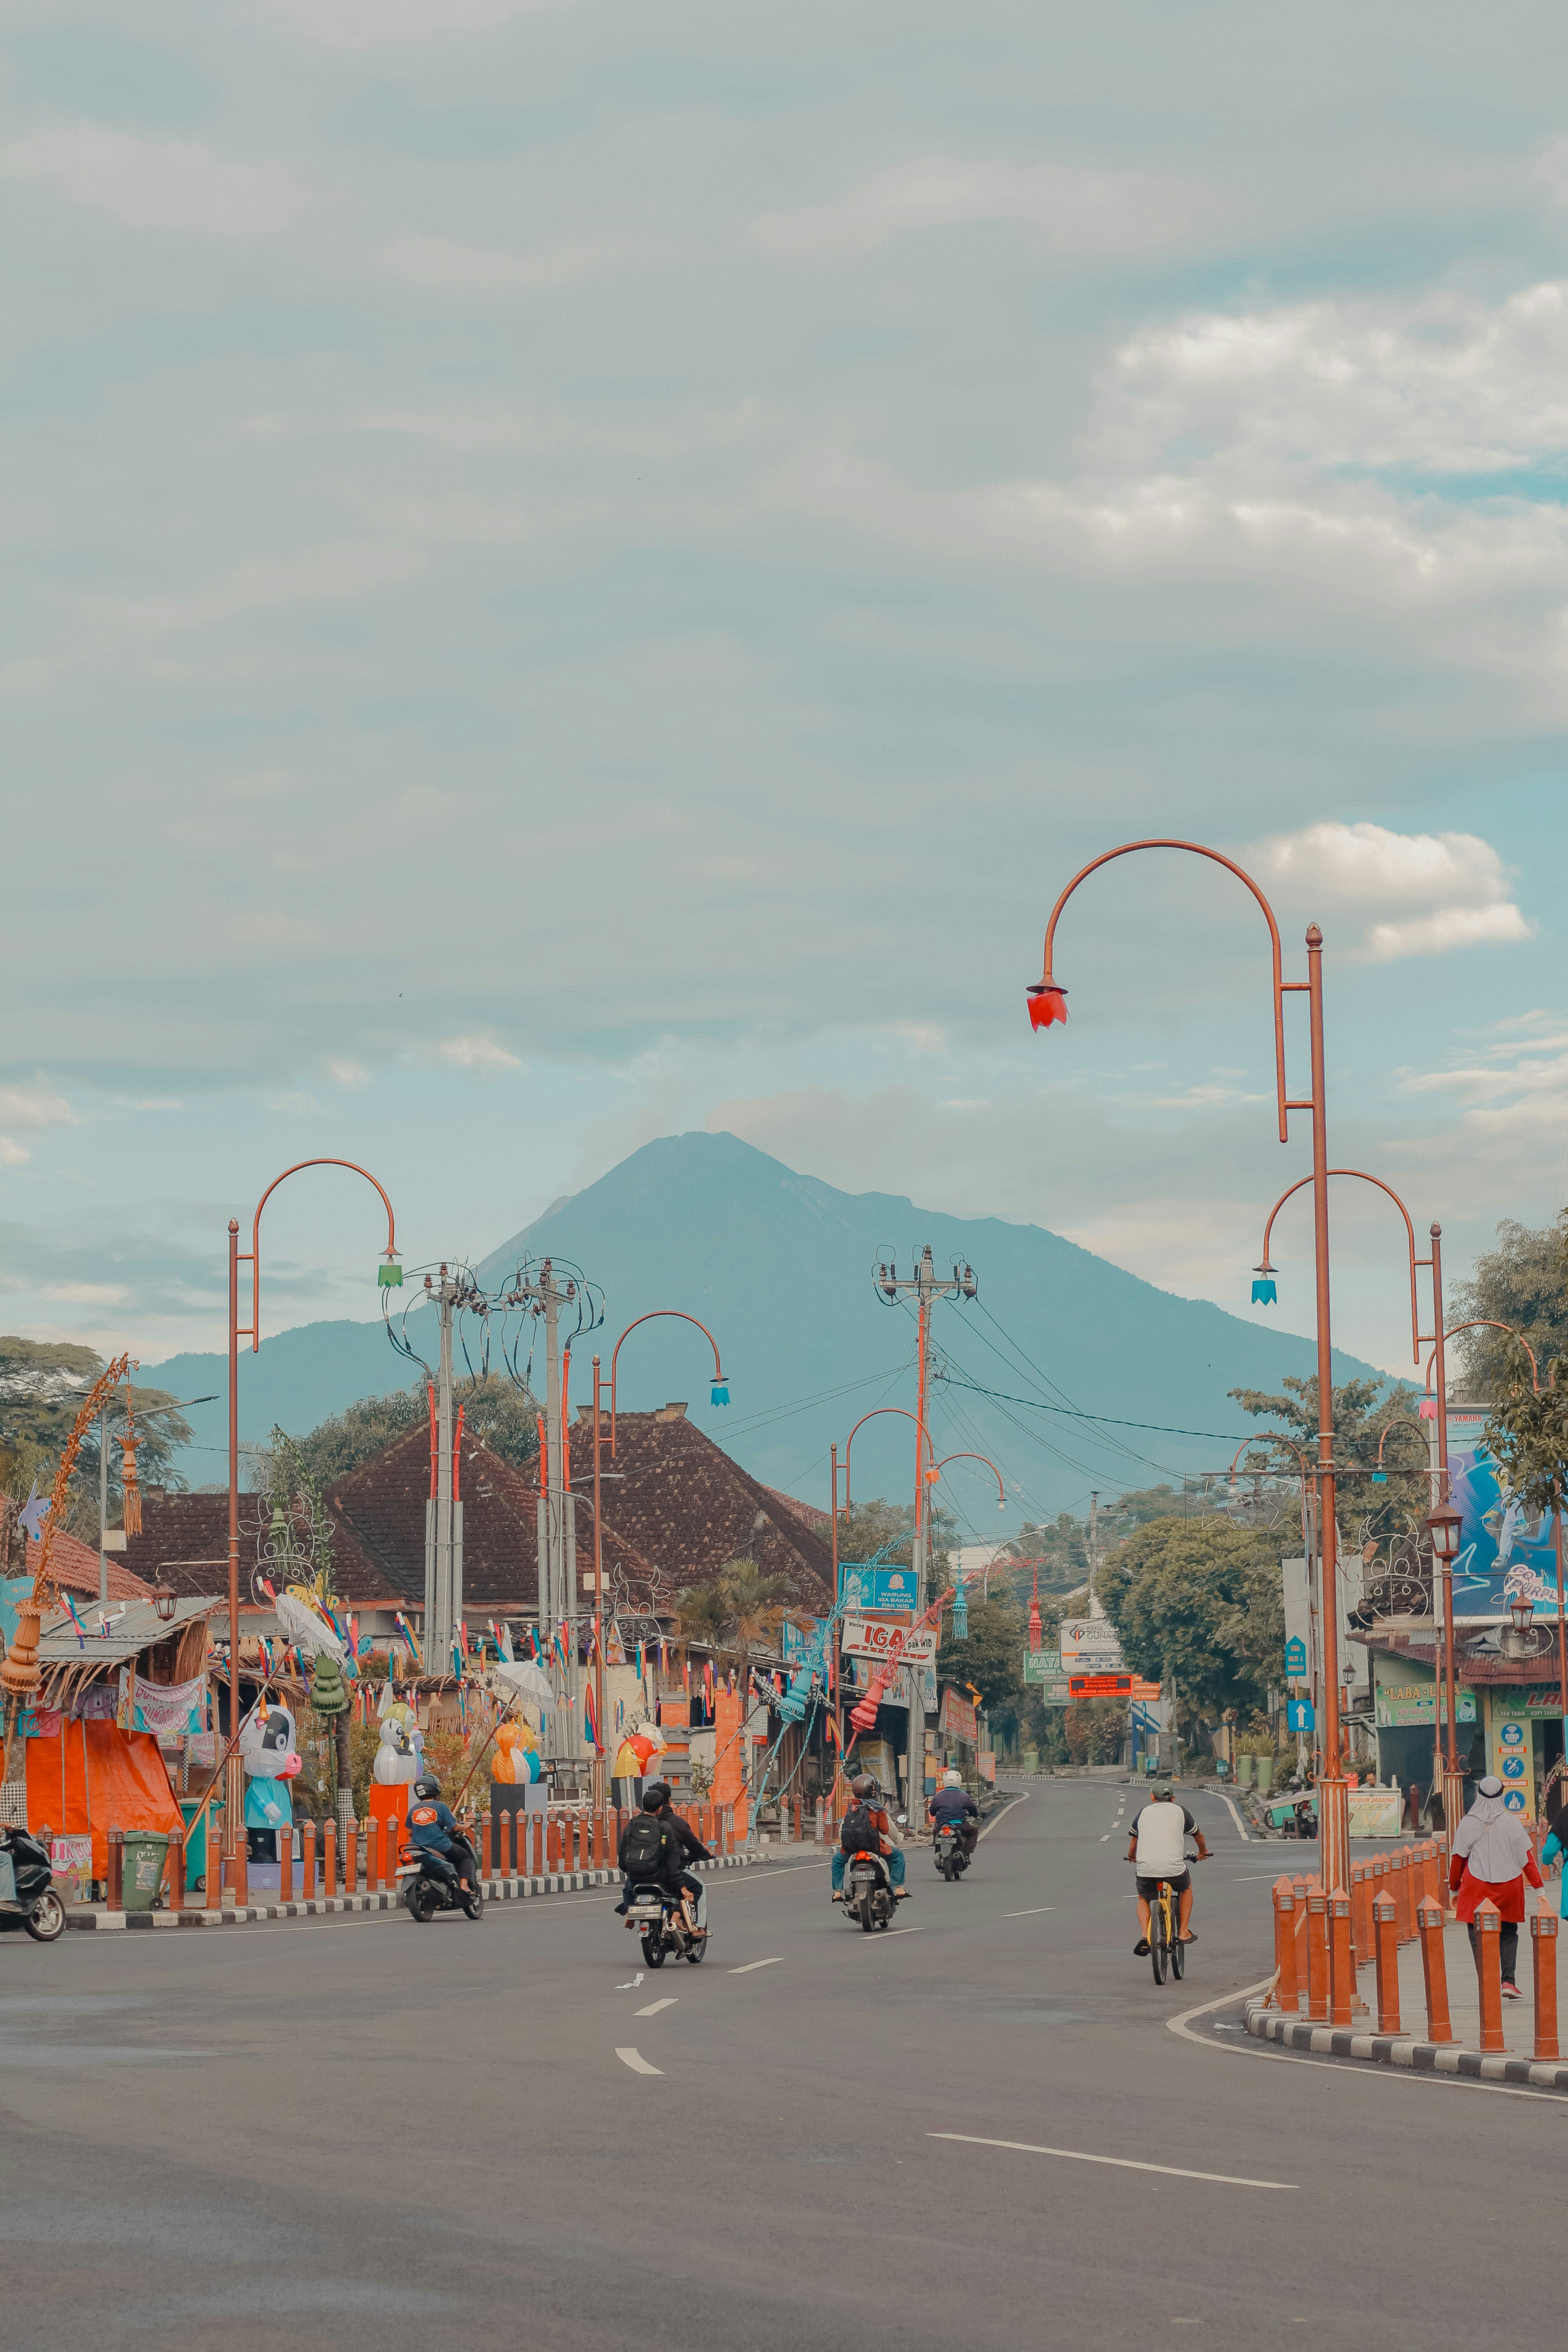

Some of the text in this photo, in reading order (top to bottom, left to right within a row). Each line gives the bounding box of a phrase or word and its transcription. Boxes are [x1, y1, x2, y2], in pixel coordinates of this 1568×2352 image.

[848, 1621, 864, 1629] Warung
[864, 1625, 905, 1649] IGA
[920, 1638, 932, 1648] WID
[1398, 1709, 1410, 1717] KOPI
[1410, 1708, 1425, 1716] TARIK
